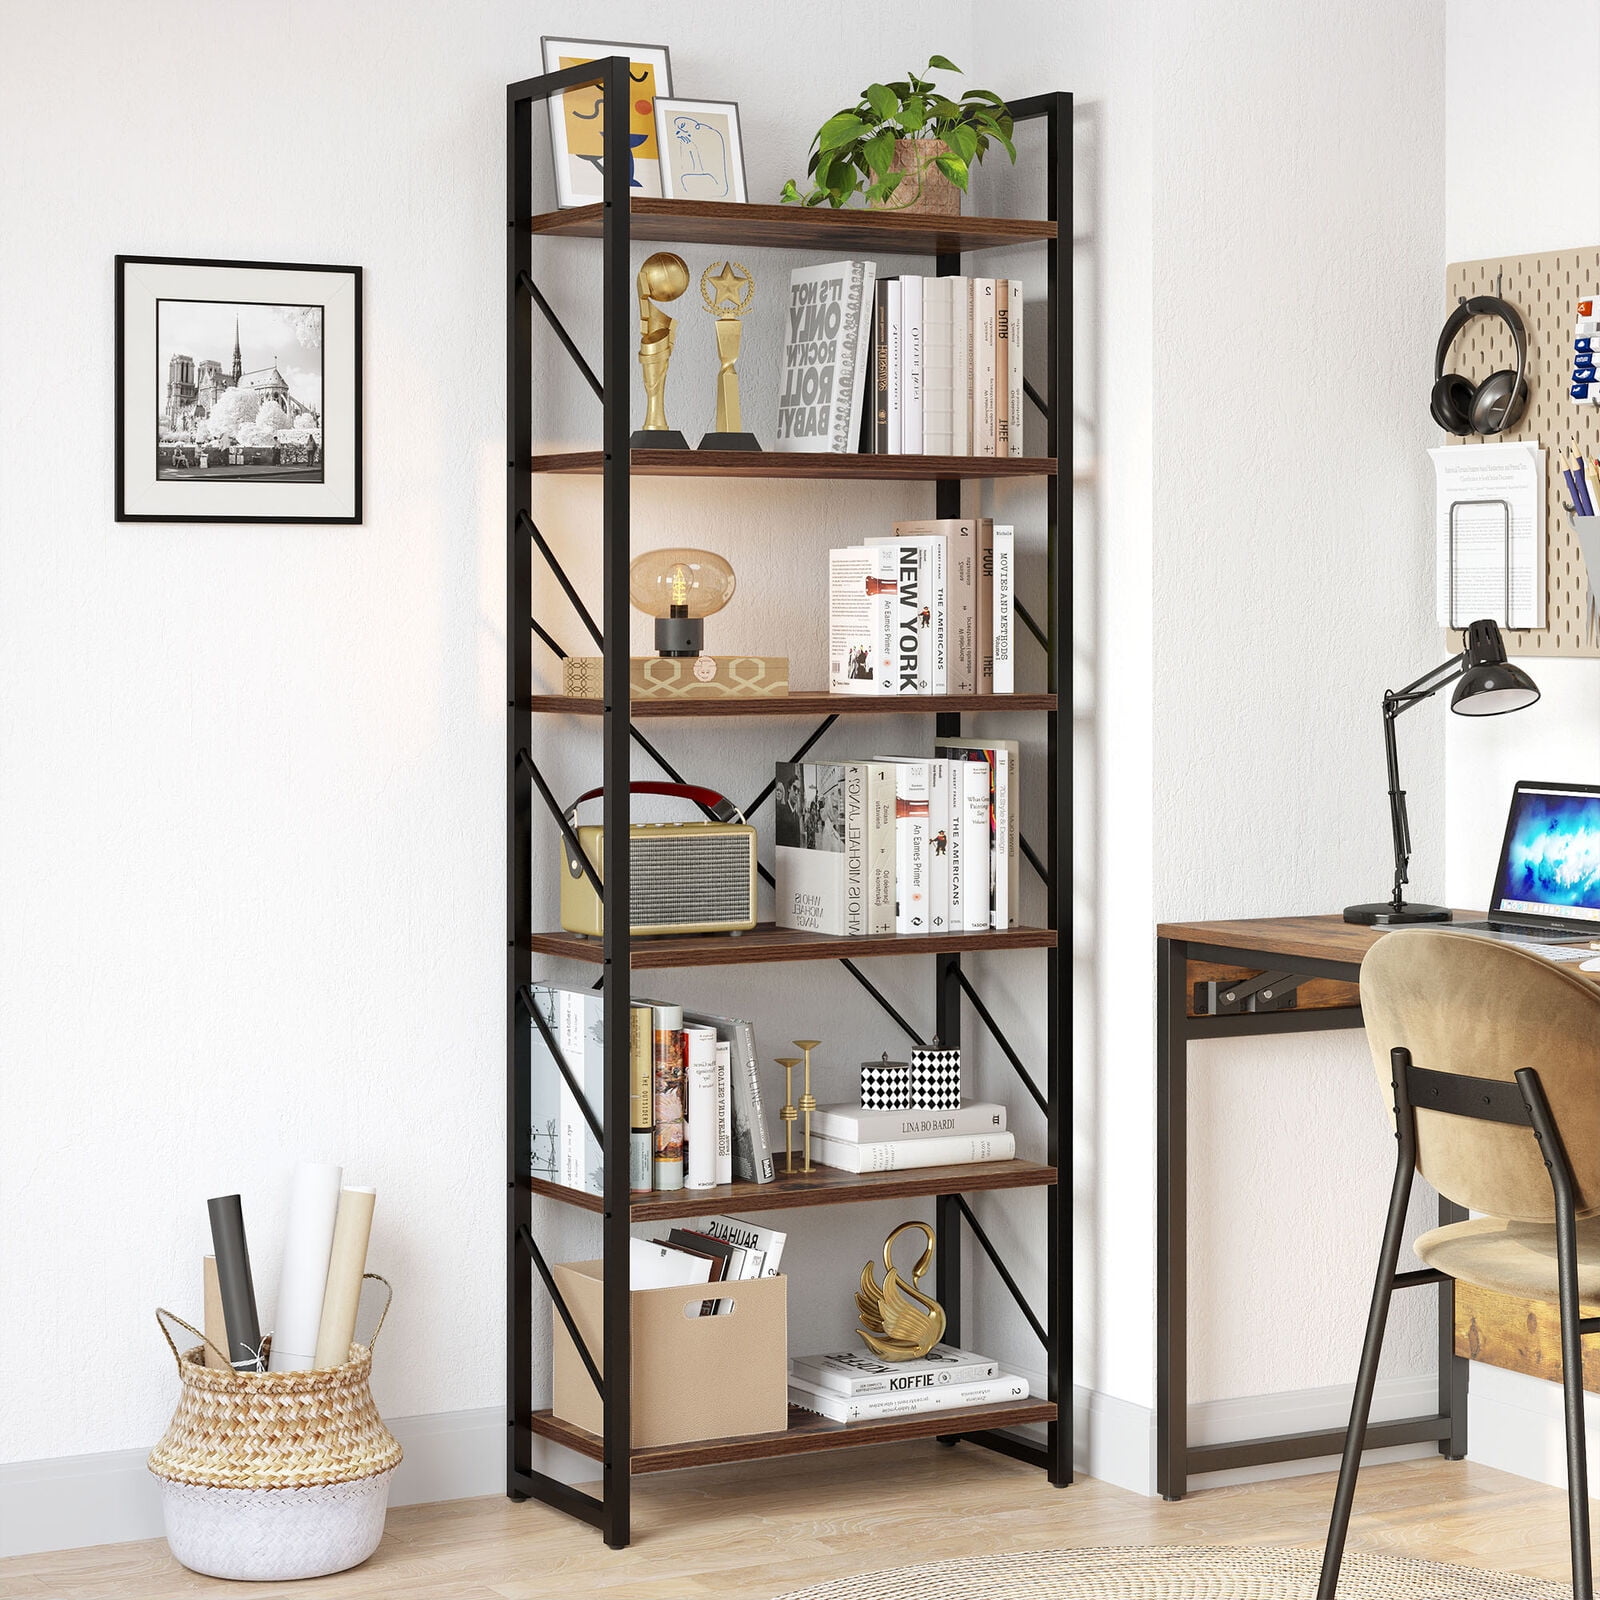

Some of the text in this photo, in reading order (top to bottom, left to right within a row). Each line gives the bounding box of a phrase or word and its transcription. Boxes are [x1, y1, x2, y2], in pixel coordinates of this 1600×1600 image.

[884, 600, 892, 655] An Eames Primer
[899, 547, 918, 691] NEW YORK
[1000, 552, 1008, 661] MOVIES AND METHODS
[878, 771, 884, 781] 1
[882, 870, 890, 878] Od
[912, 824, 922, 888] An Eames Primer
[952, 817, 960, 906] THE AMERICANS
[902, 1118, 955, 1134] LINA BO BARDI
[889, 1373, 935, 1391] KOFFIE
